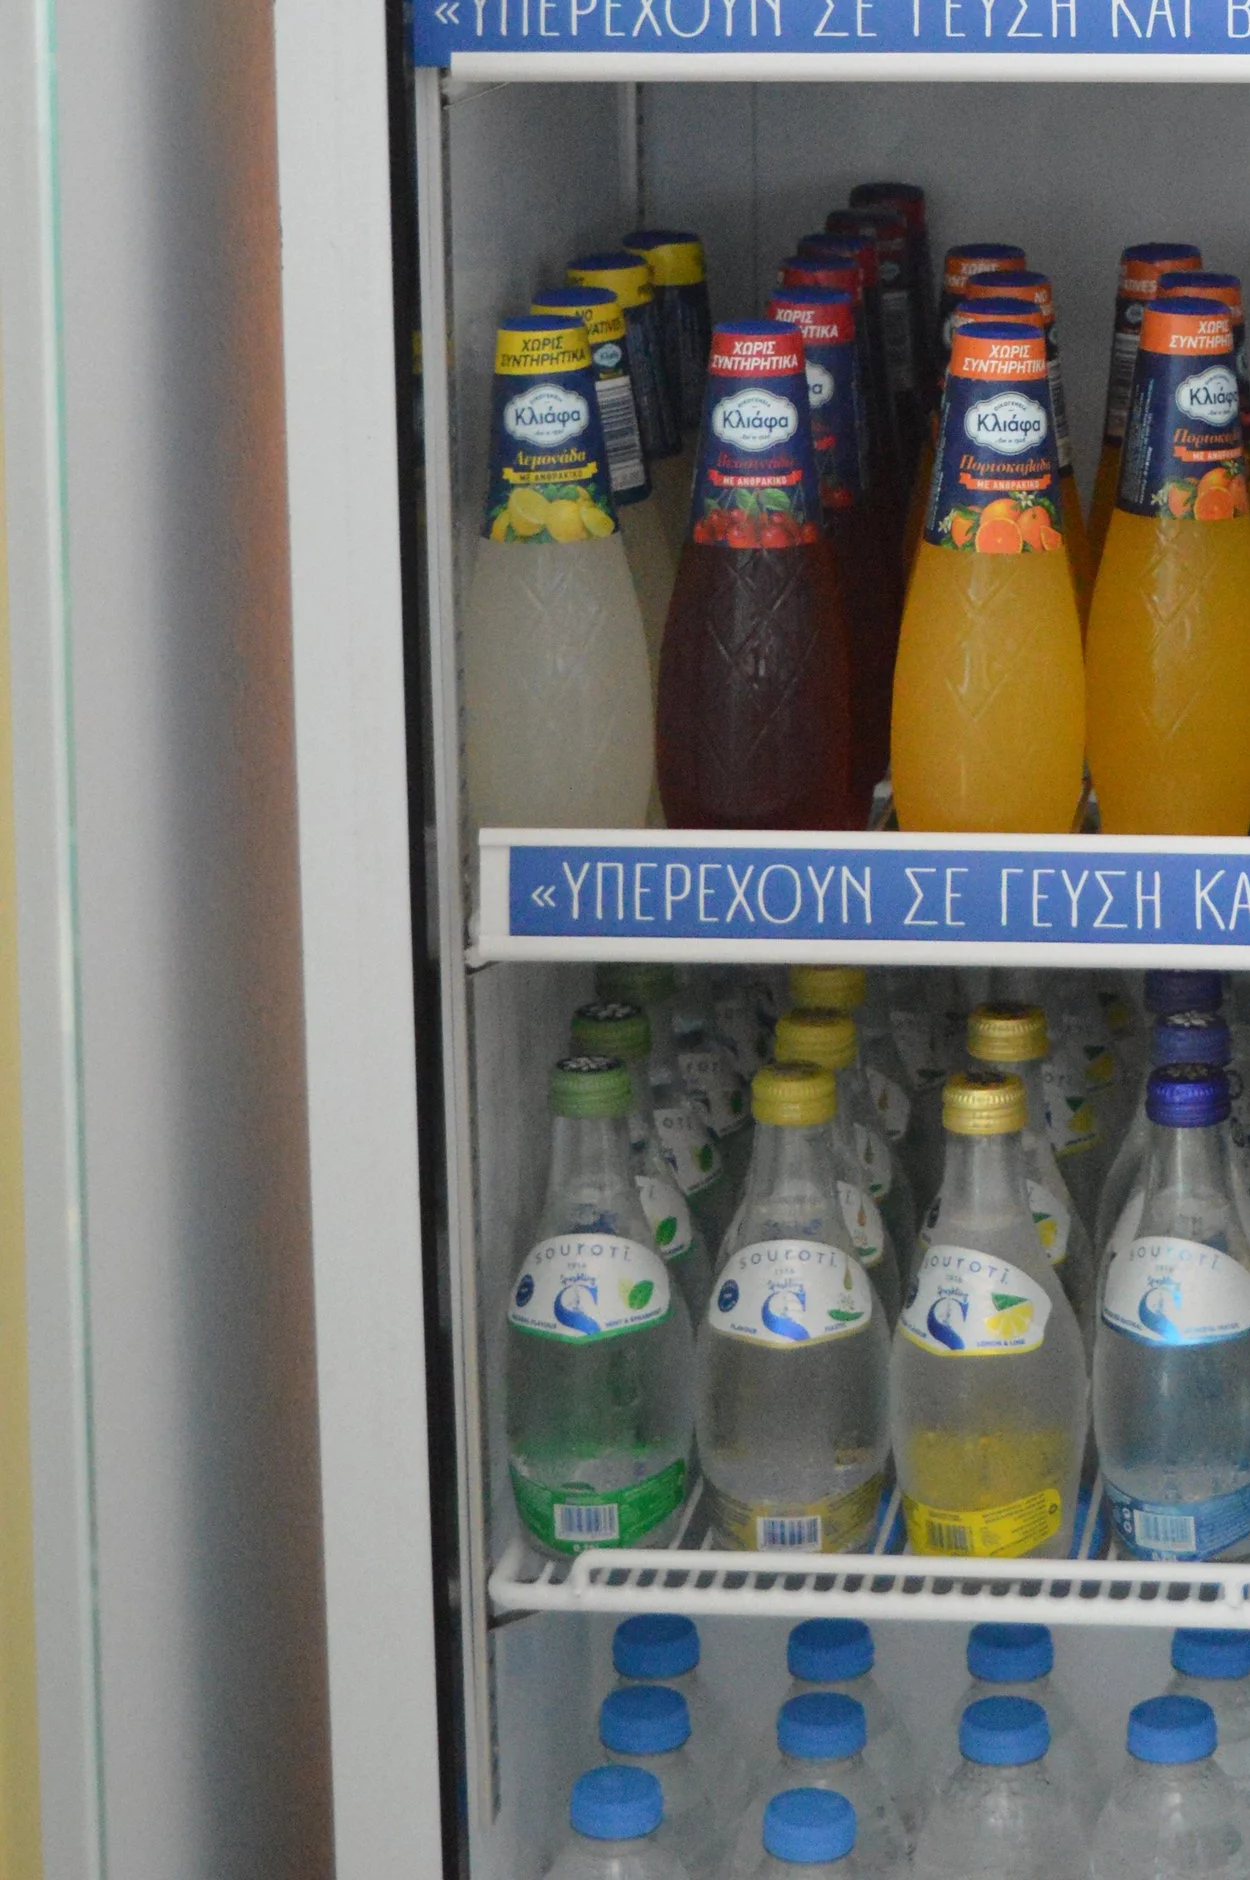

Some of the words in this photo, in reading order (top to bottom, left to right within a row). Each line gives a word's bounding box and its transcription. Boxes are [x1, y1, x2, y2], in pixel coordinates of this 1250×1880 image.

[521, 335, 564, 352] ΧΩΡΙΣ
[733, 340, 776, 356] ΧΩΡΙΣ
[989, 344, 1032, 359] ΧΩΡΙΣ
[501, 351, 586, 368] ΣΥΝΤΗΡΗΤΙΚΑ
[711, 352, 799, 370] ΣΥΝΤΗΡΗΤΙΚΑ
[514, 405, 582, 428] Κλιάφα
[722, 409, 789, 433] Κλιάφα
[976, 412, 1041, 437] Κλιάφα
[530, 860, 872, 925] «ΥΠΕΡΕΧΟΥΝ
[904, 866, 966, 926] ΣΕ
[1000, 868, 1160, 930] ΓΕΥΣΗ
